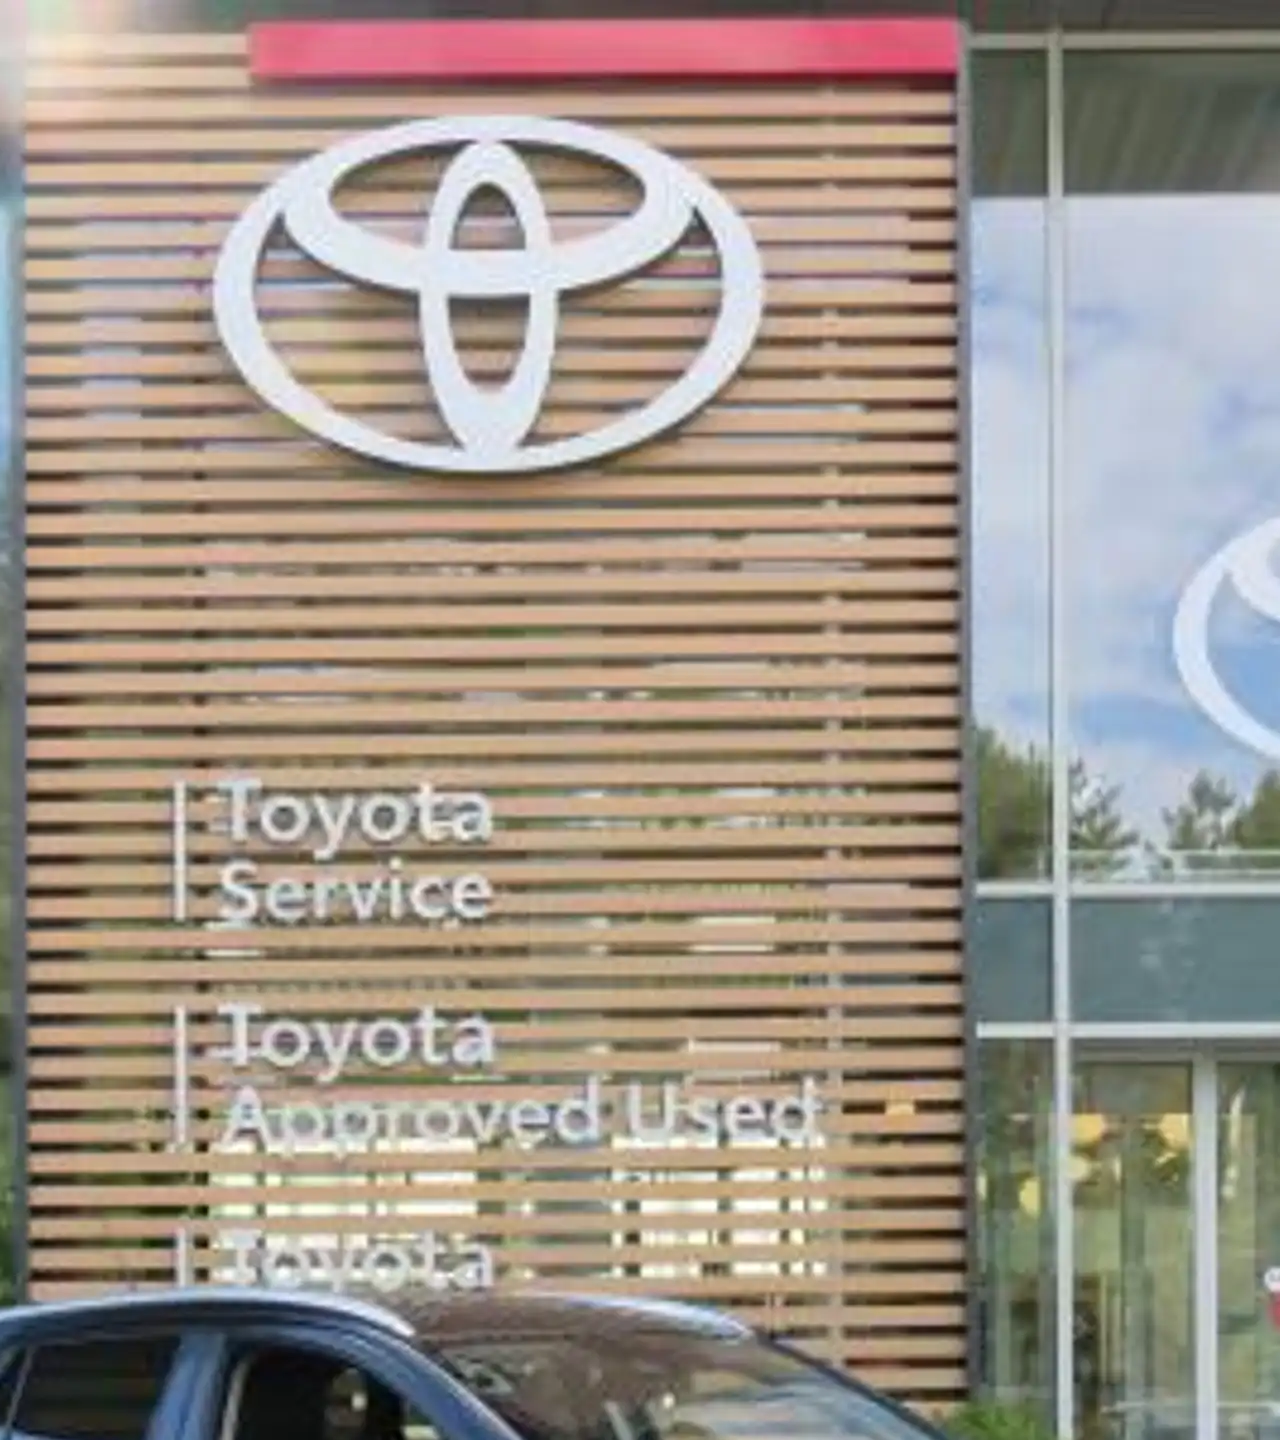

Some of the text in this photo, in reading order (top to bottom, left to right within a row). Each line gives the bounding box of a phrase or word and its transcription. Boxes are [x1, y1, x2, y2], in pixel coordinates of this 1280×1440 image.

[219, 778, 493, 861] Toyota
[221, 858, 493, 919] Service
[218, 1003, 495, 1083] Toyota
[221, 1076, 821, 1158] Approved Used
[218, 1230, 493, 1293] Toyota
